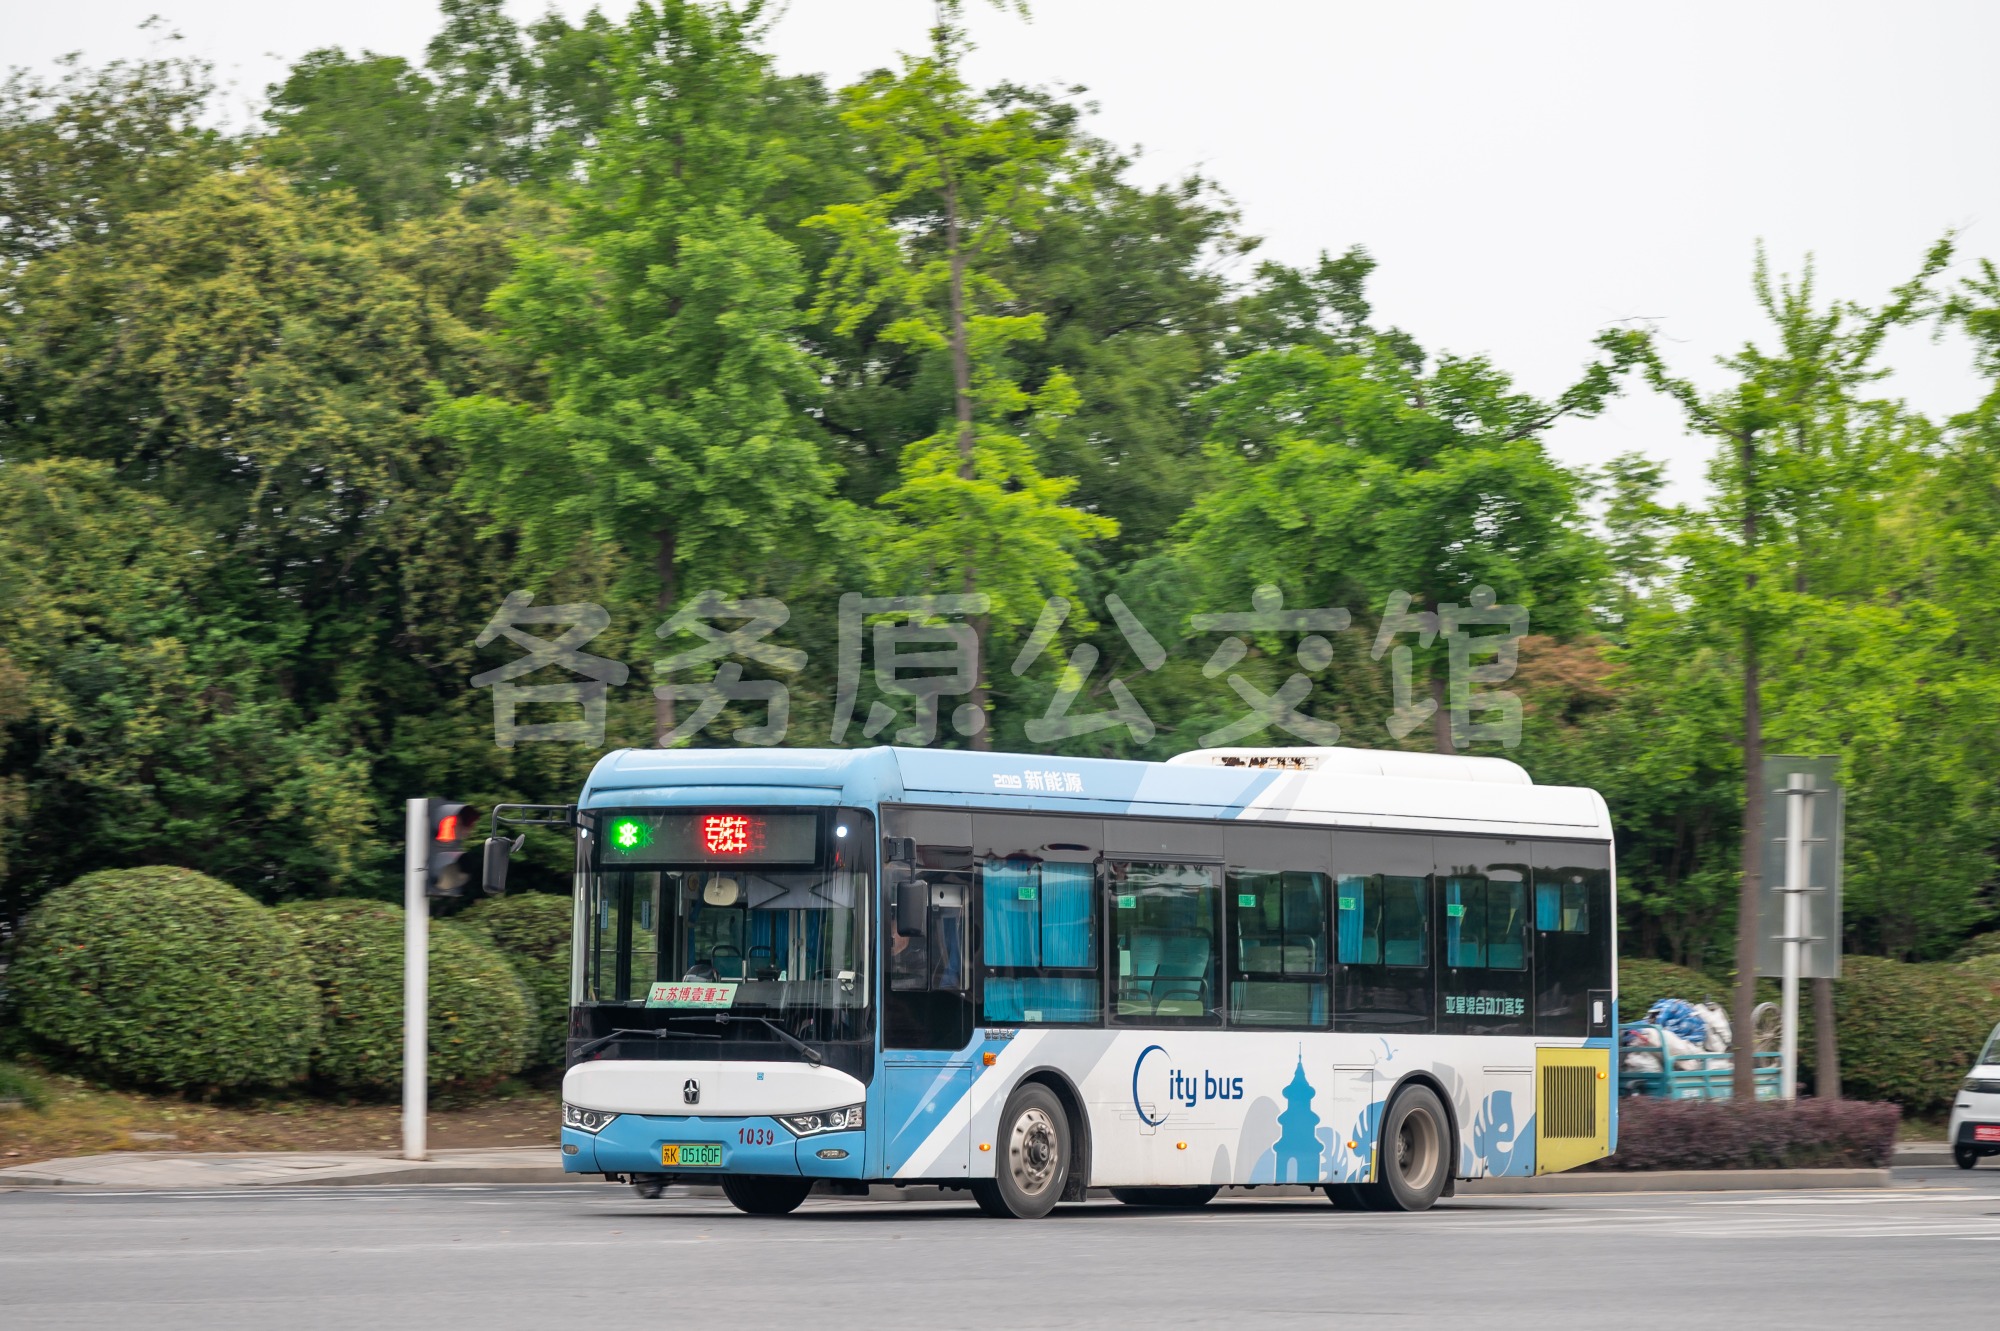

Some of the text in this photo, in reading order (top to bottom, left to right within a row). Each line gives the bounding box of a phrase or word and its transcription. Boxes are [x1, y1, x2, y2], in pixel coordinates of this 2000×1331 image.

[1024, 770, 1083, 792] 新能源
[654, 987, 729, 1002] 江苏博壹重工
[1446, 996, 1525, 1015] 亚星混合动力客车
[1205, 1070, 1243, 1099] bus
[738, 1128, 774, 1146] 1039
